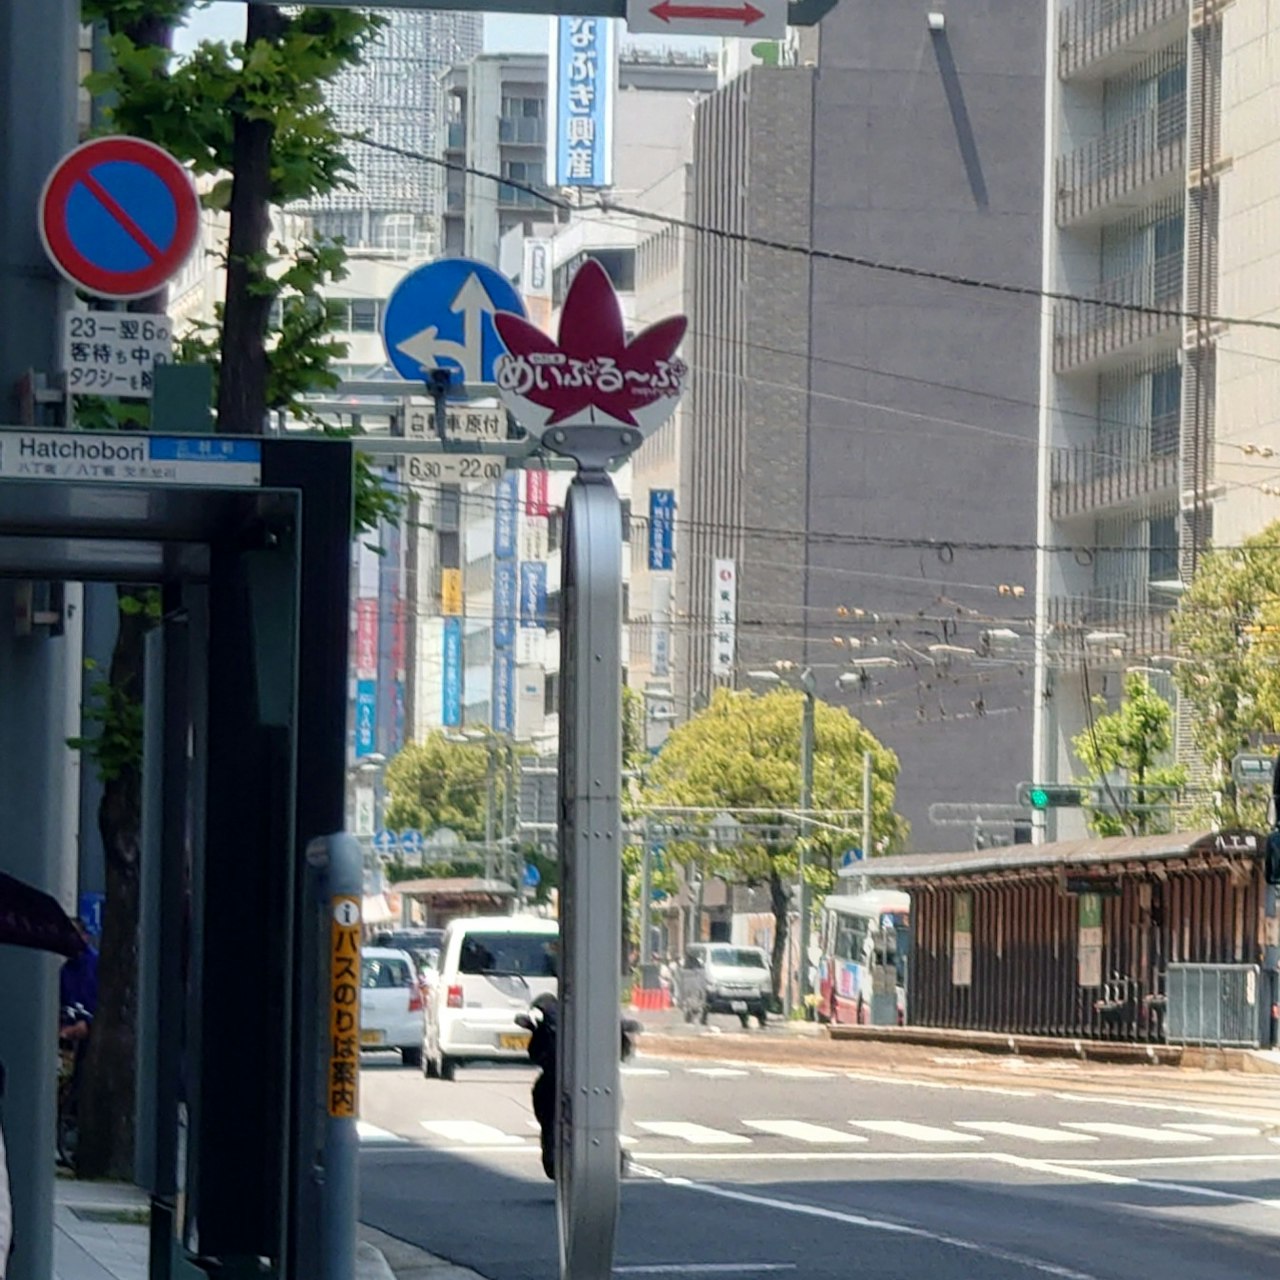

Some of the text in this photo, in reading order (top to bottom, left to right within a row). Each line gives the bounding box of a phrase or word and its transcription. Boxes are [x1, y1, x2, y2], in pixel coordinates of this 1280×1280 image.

[19, 438, 145, 462] Hatchobori
[330, 929, 357, 1114] バスのりば案内
